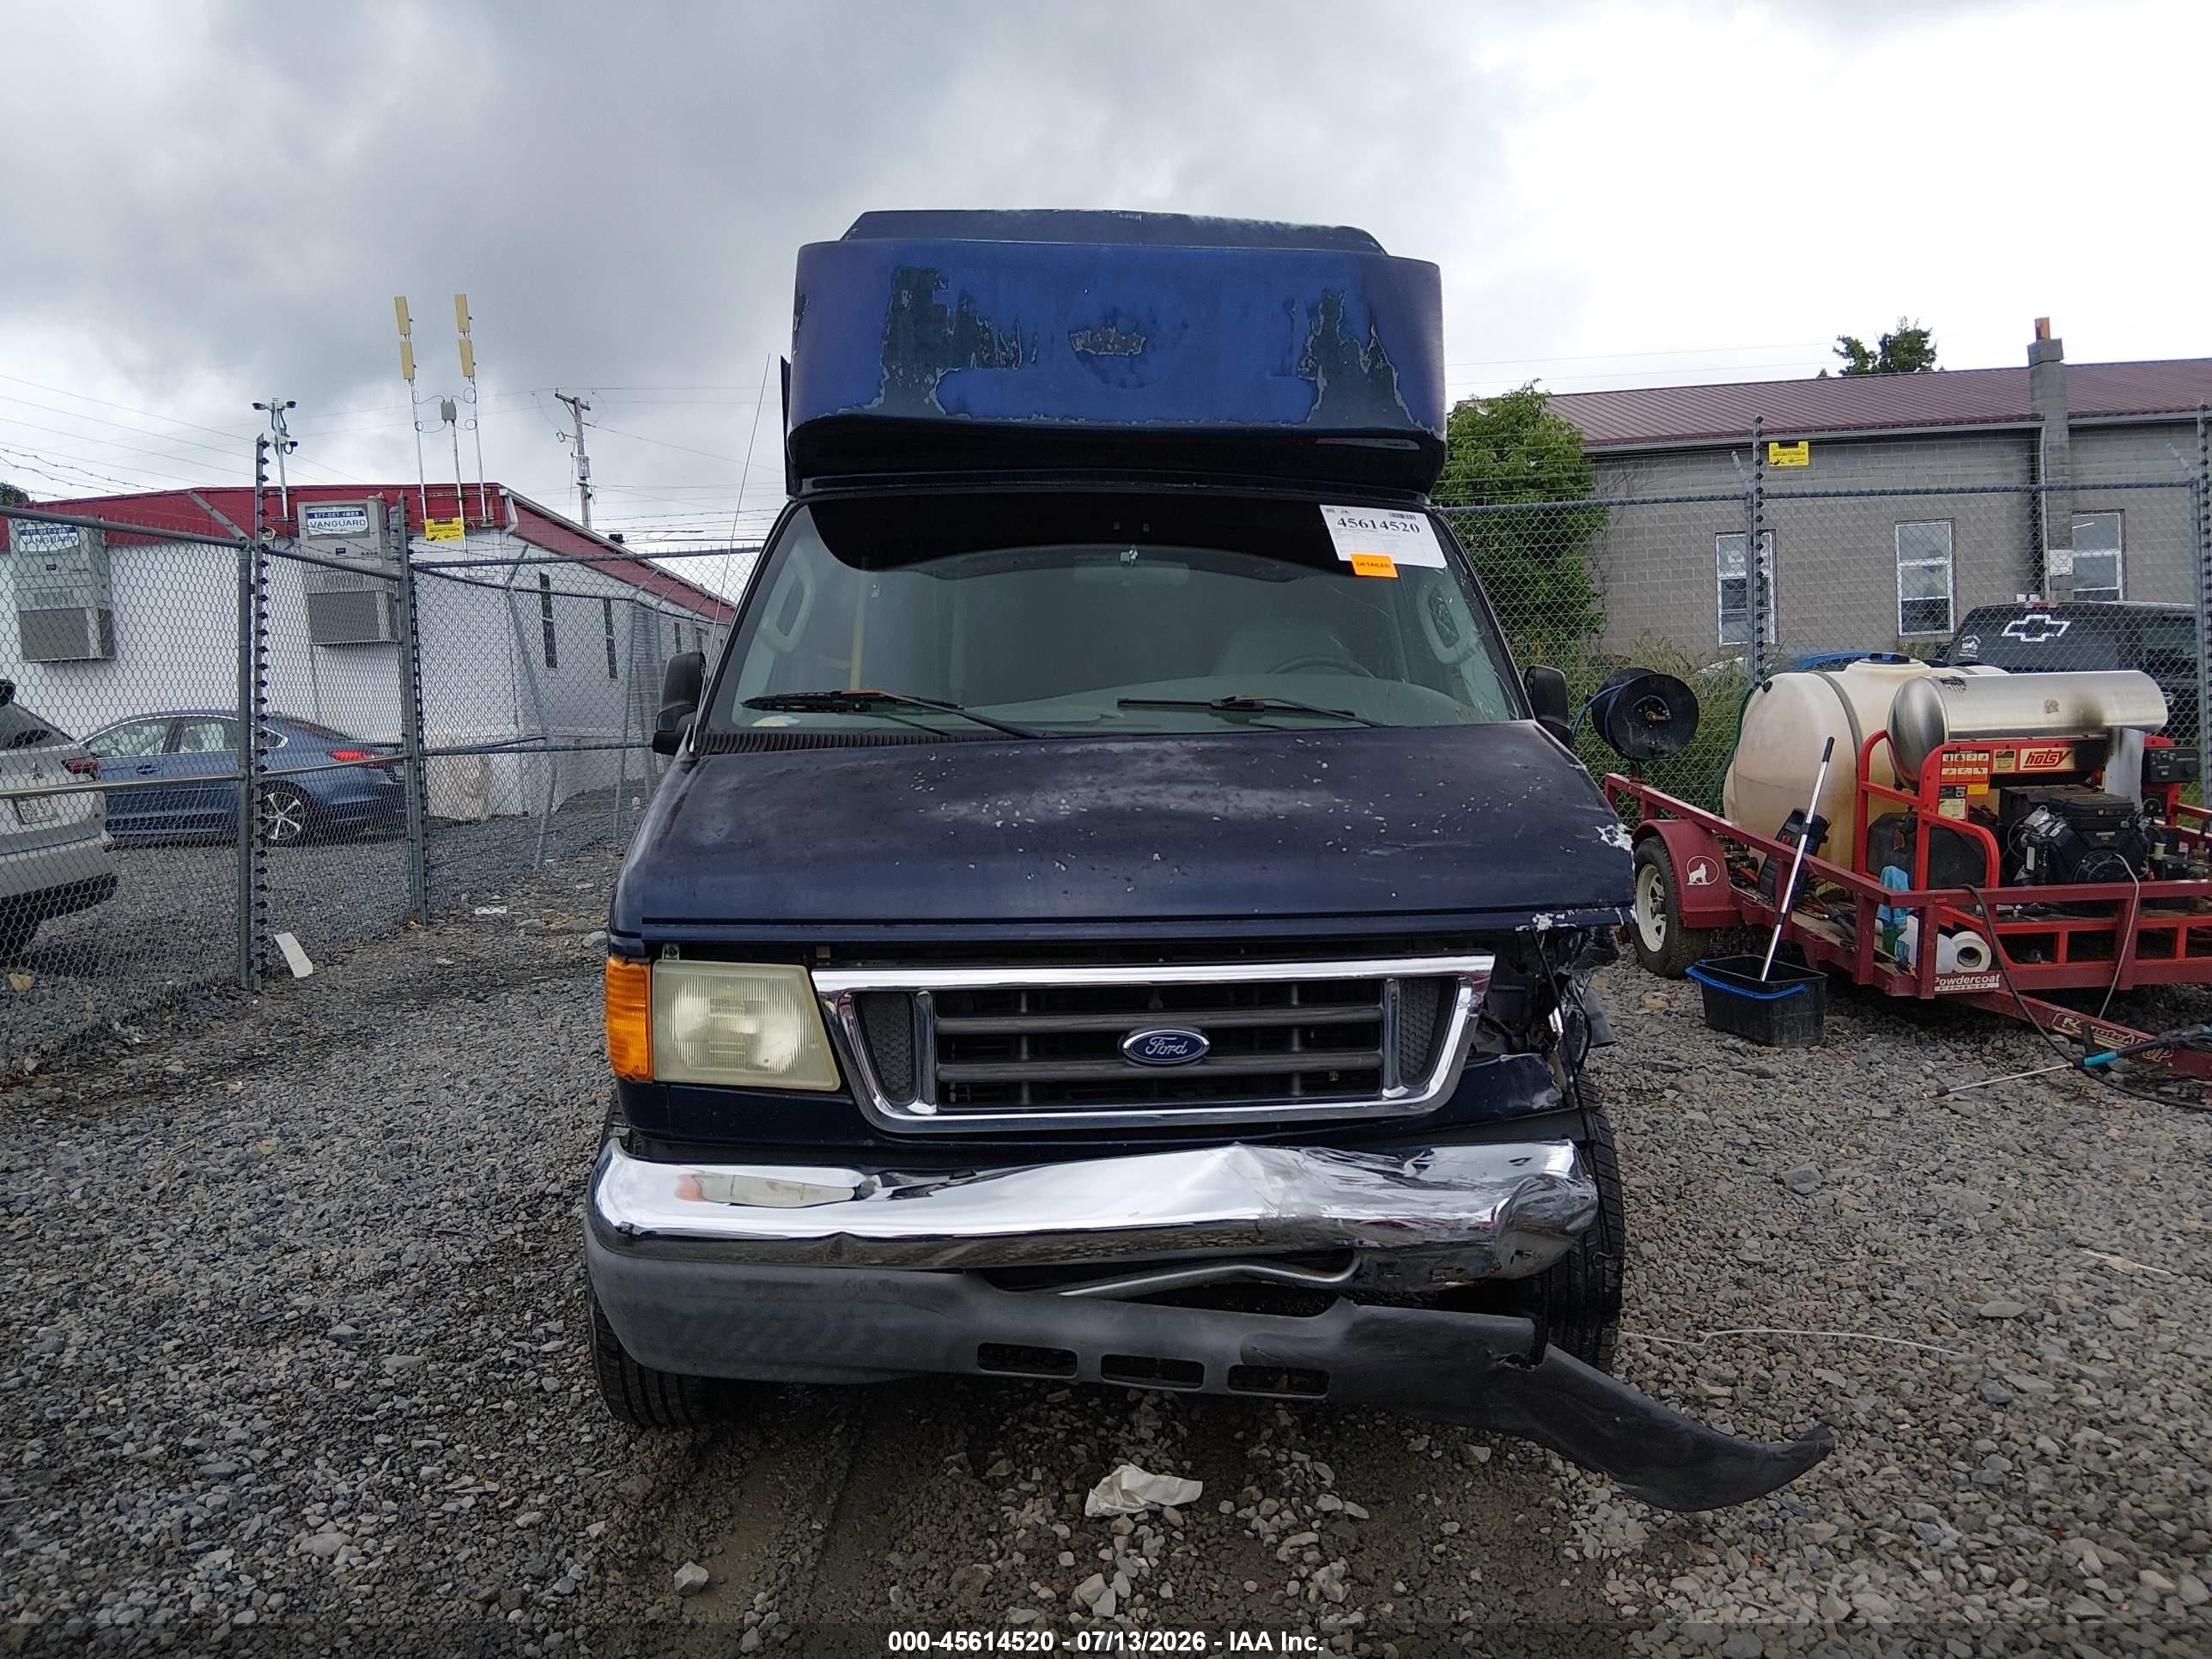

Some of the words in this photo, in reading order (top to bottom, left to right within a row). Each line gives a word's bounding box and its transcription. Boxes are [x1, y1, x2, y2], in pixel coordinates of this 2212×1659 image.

[309, 519, 367, 528] VANGUARD
[1337, 517, 1420, 533] 45614520
[1145, 1036, 1188, 1055] Ford
